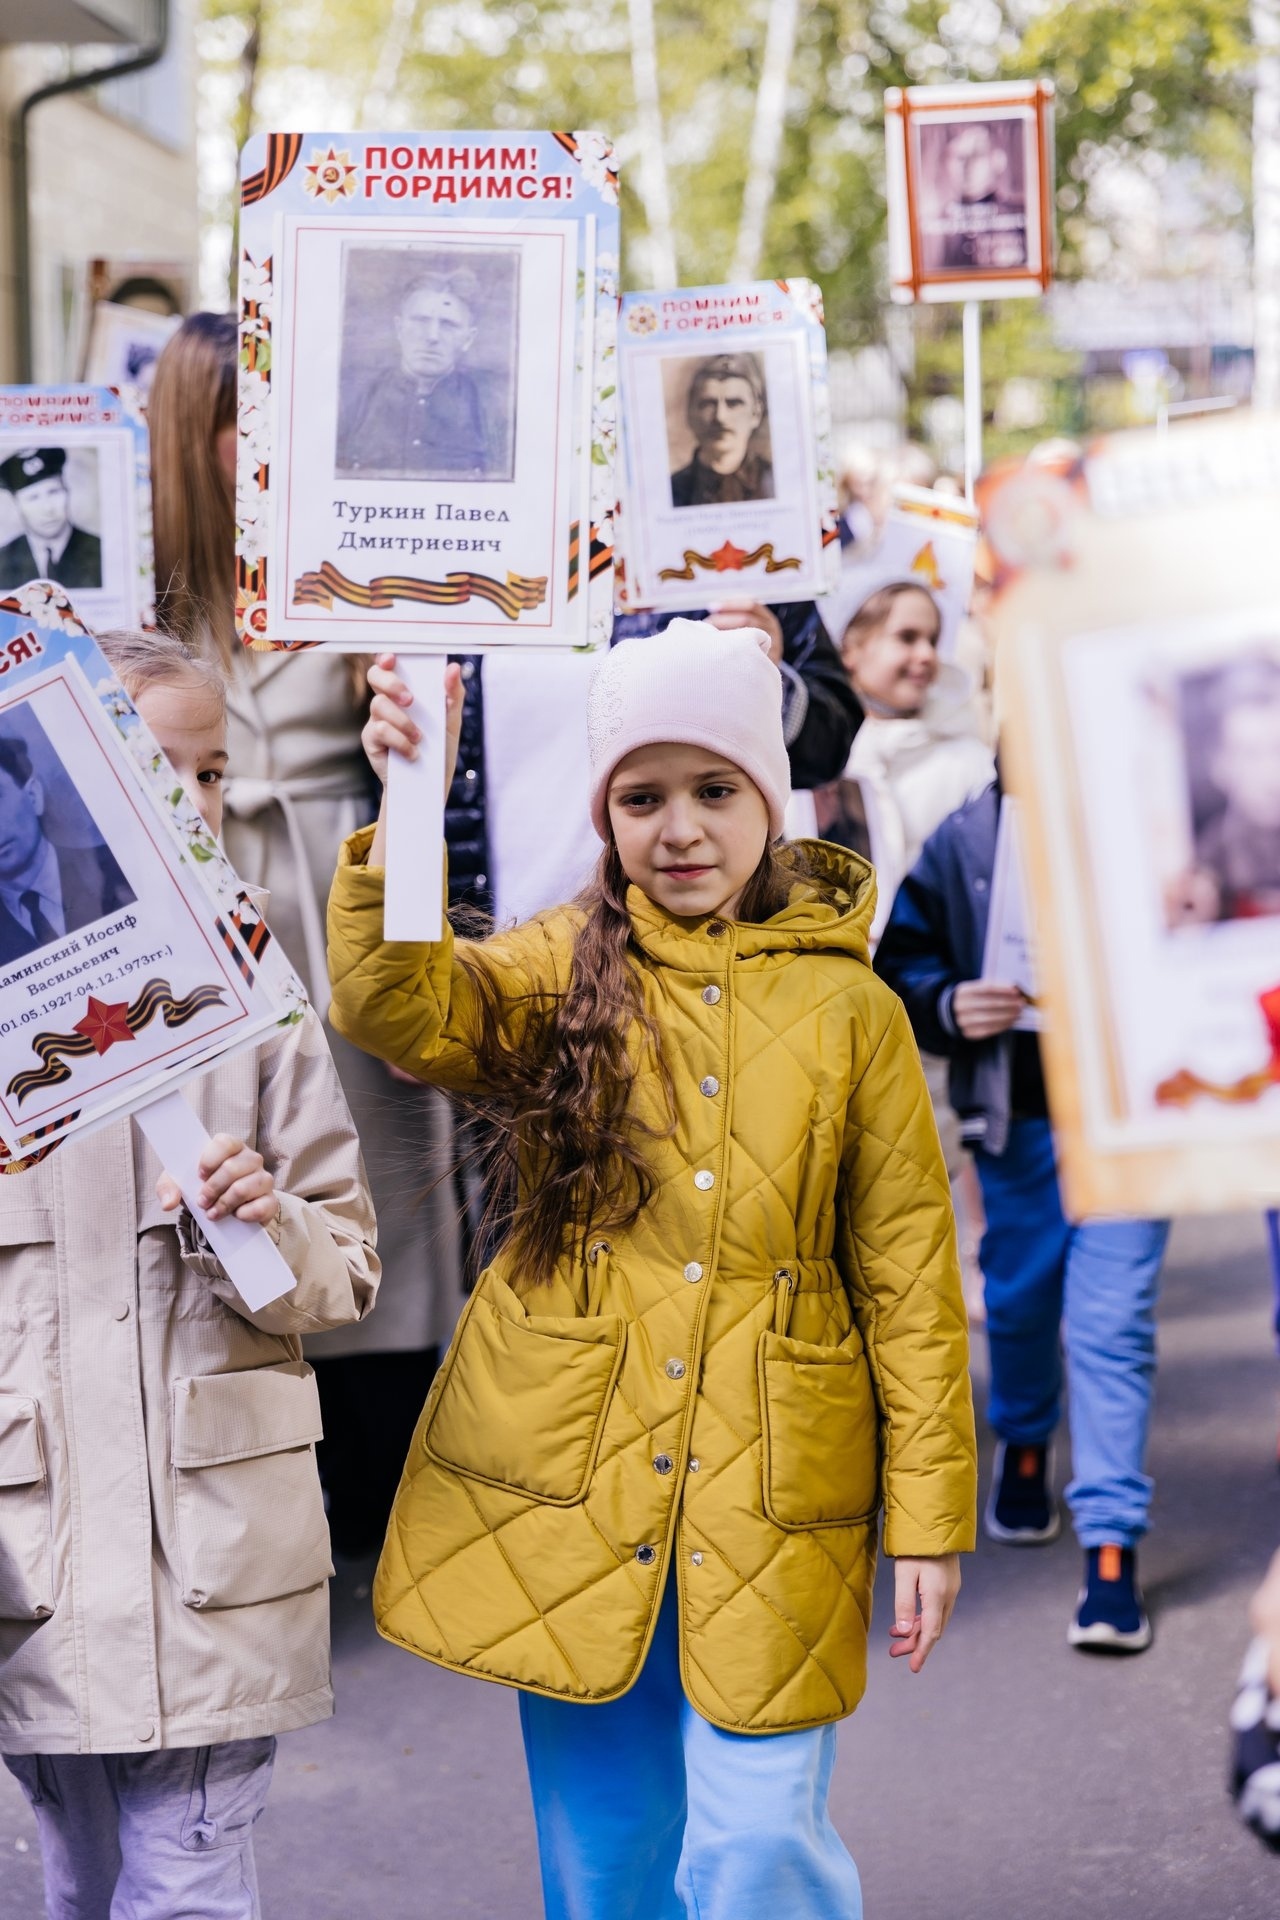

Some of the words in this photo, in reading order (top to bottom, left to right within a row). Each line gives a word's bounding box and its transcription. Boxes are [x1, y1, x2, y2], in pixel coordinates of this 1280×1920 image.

[365, 147, 537, 170] ПОМНИМ!
[365, 175, 573, 203] ГОРДИМСЯ!
[333, 501, 426, 523] Туркин
[436, 504, 511, 522] Павел
[337, 531, 502, 555] Дмитриевич
[0, 941, 82, 989] аминский
[83, 914, 138, 947] Иосиф
[26, 946, 120, 997] Васильевич
